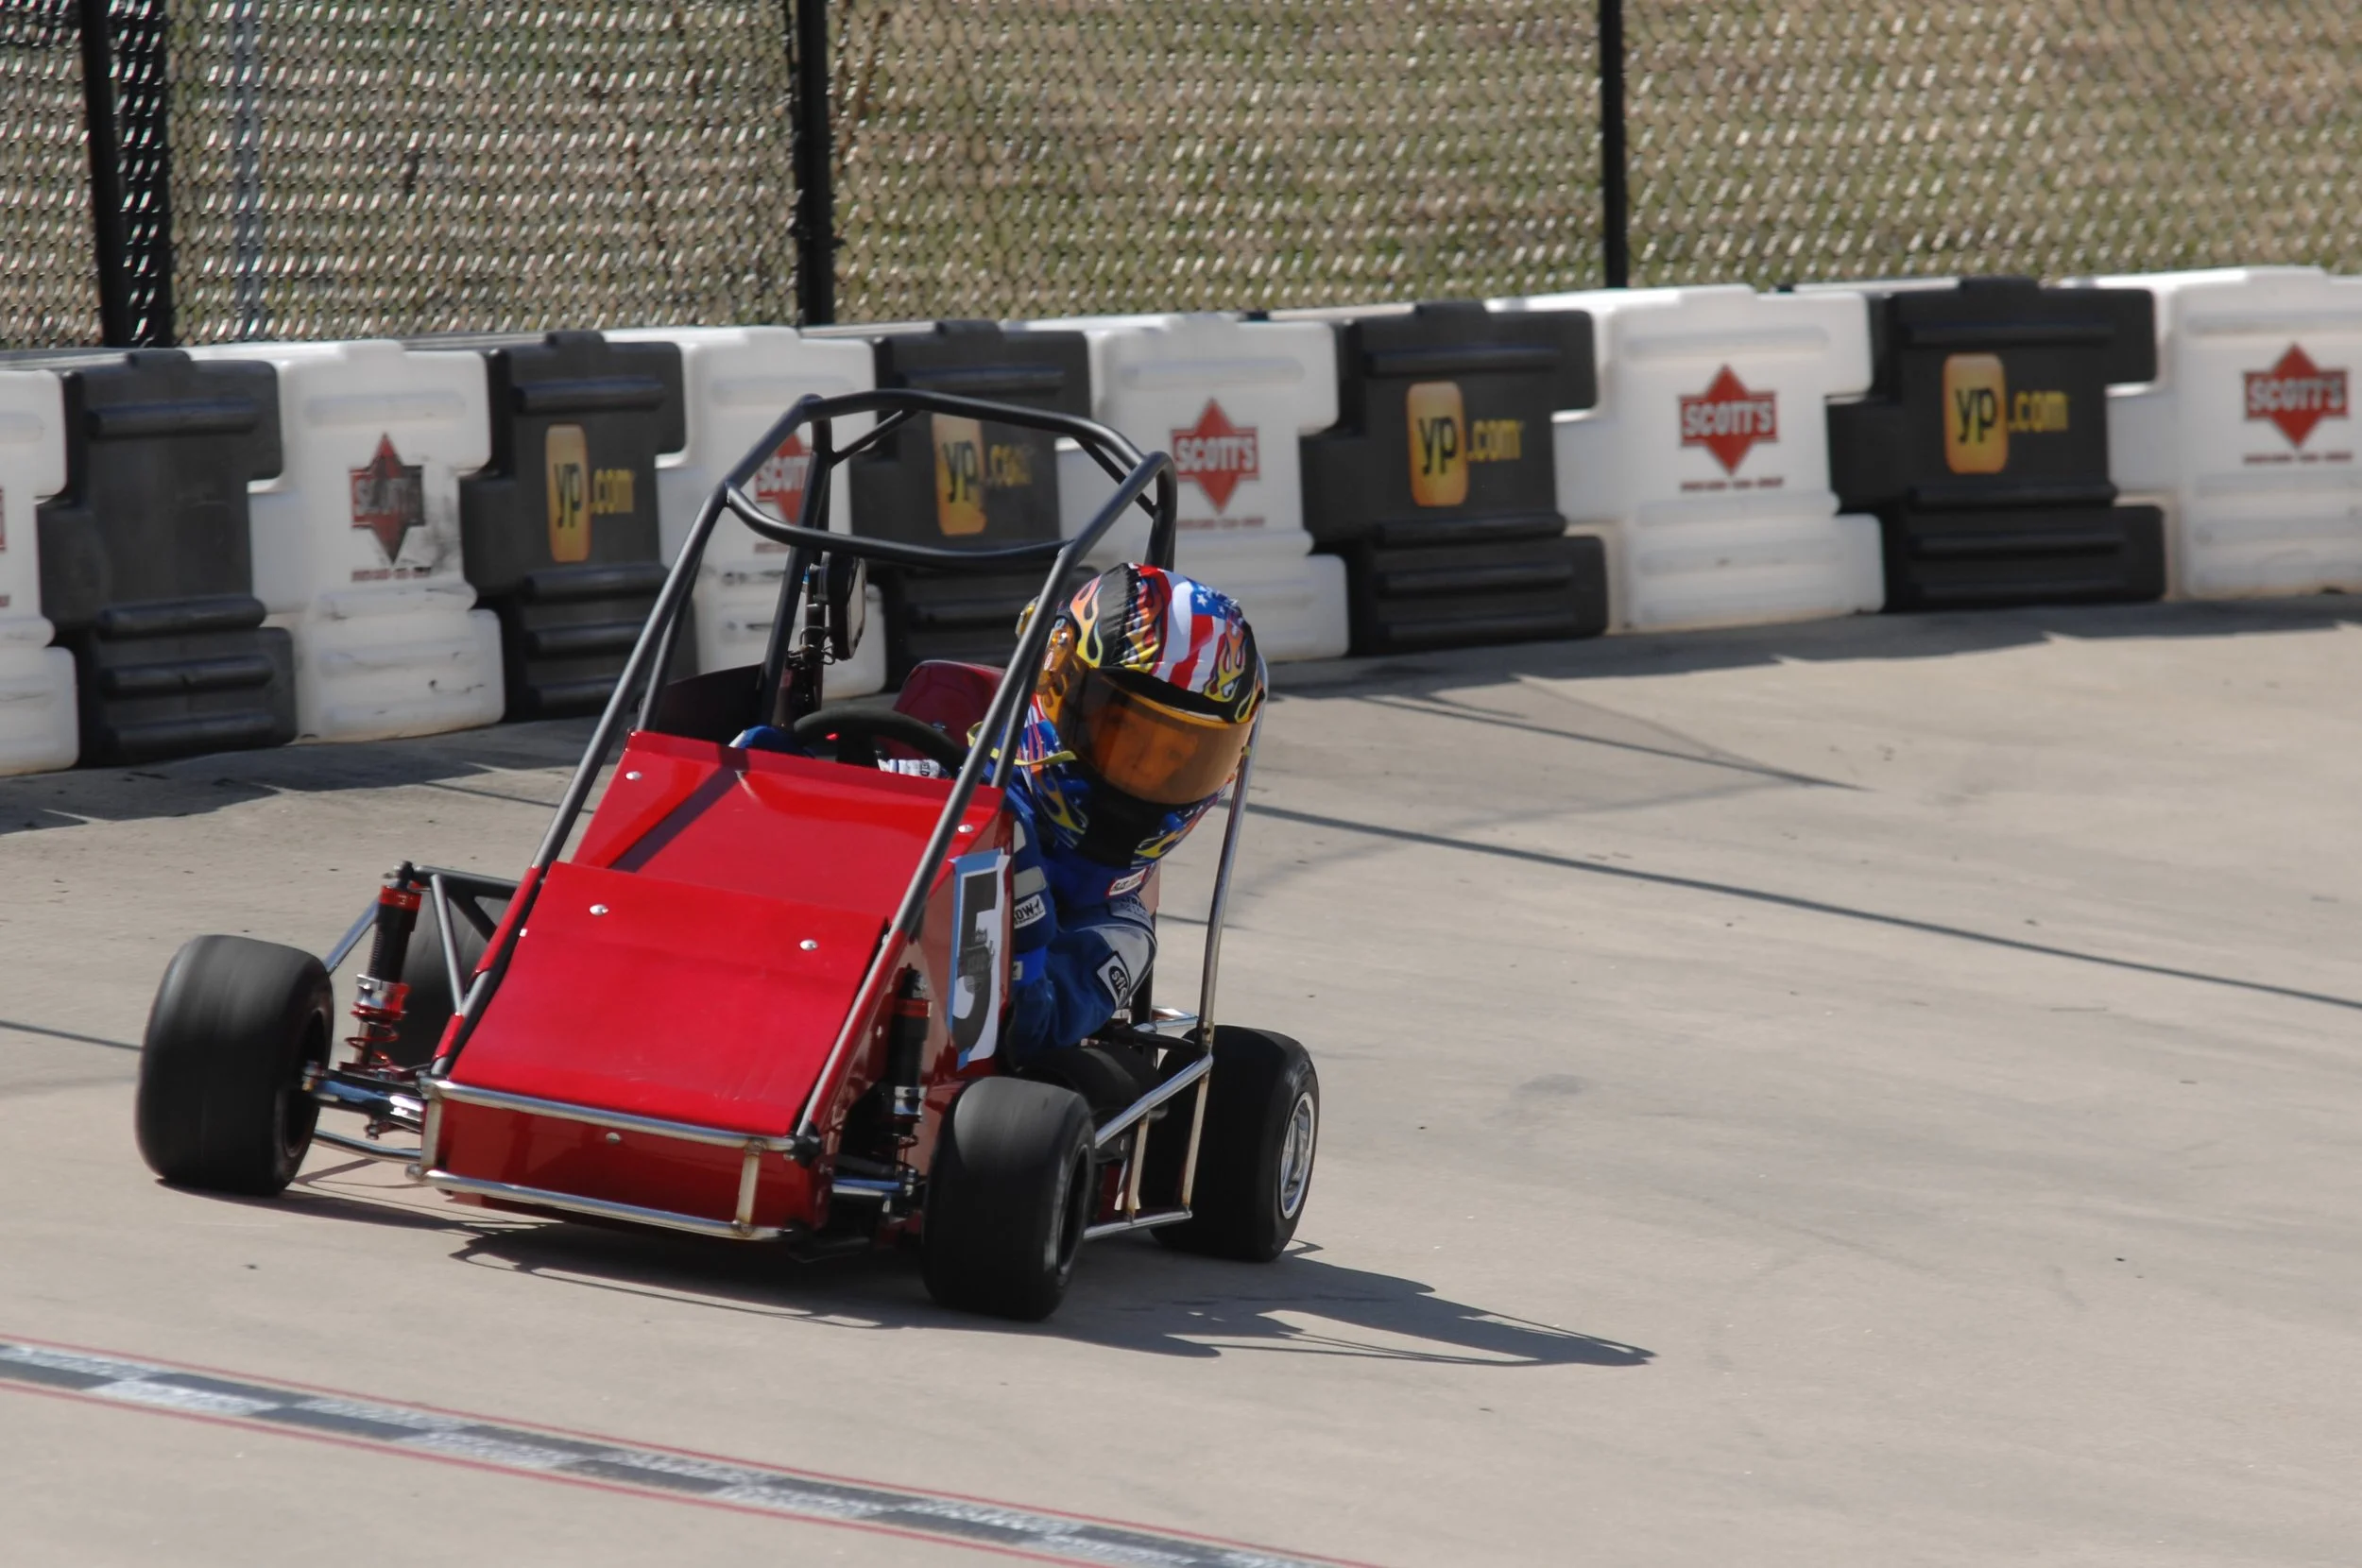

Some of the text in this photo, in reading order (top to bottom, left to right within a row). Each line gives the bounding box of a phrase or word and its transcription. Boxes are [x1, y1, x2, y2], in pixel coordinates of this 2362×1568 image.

[1684, 400, 1773, 436] SCOTT'S
[1955, 387, 2067, 444] yp.com
[2249, 378, 2344, 411] SCOTT'S
[1175, 435, 1257, 472] SCOTT'S
[1418, 417, 1522, 475] yp.com
[952, 870, 998, 1052] 5
